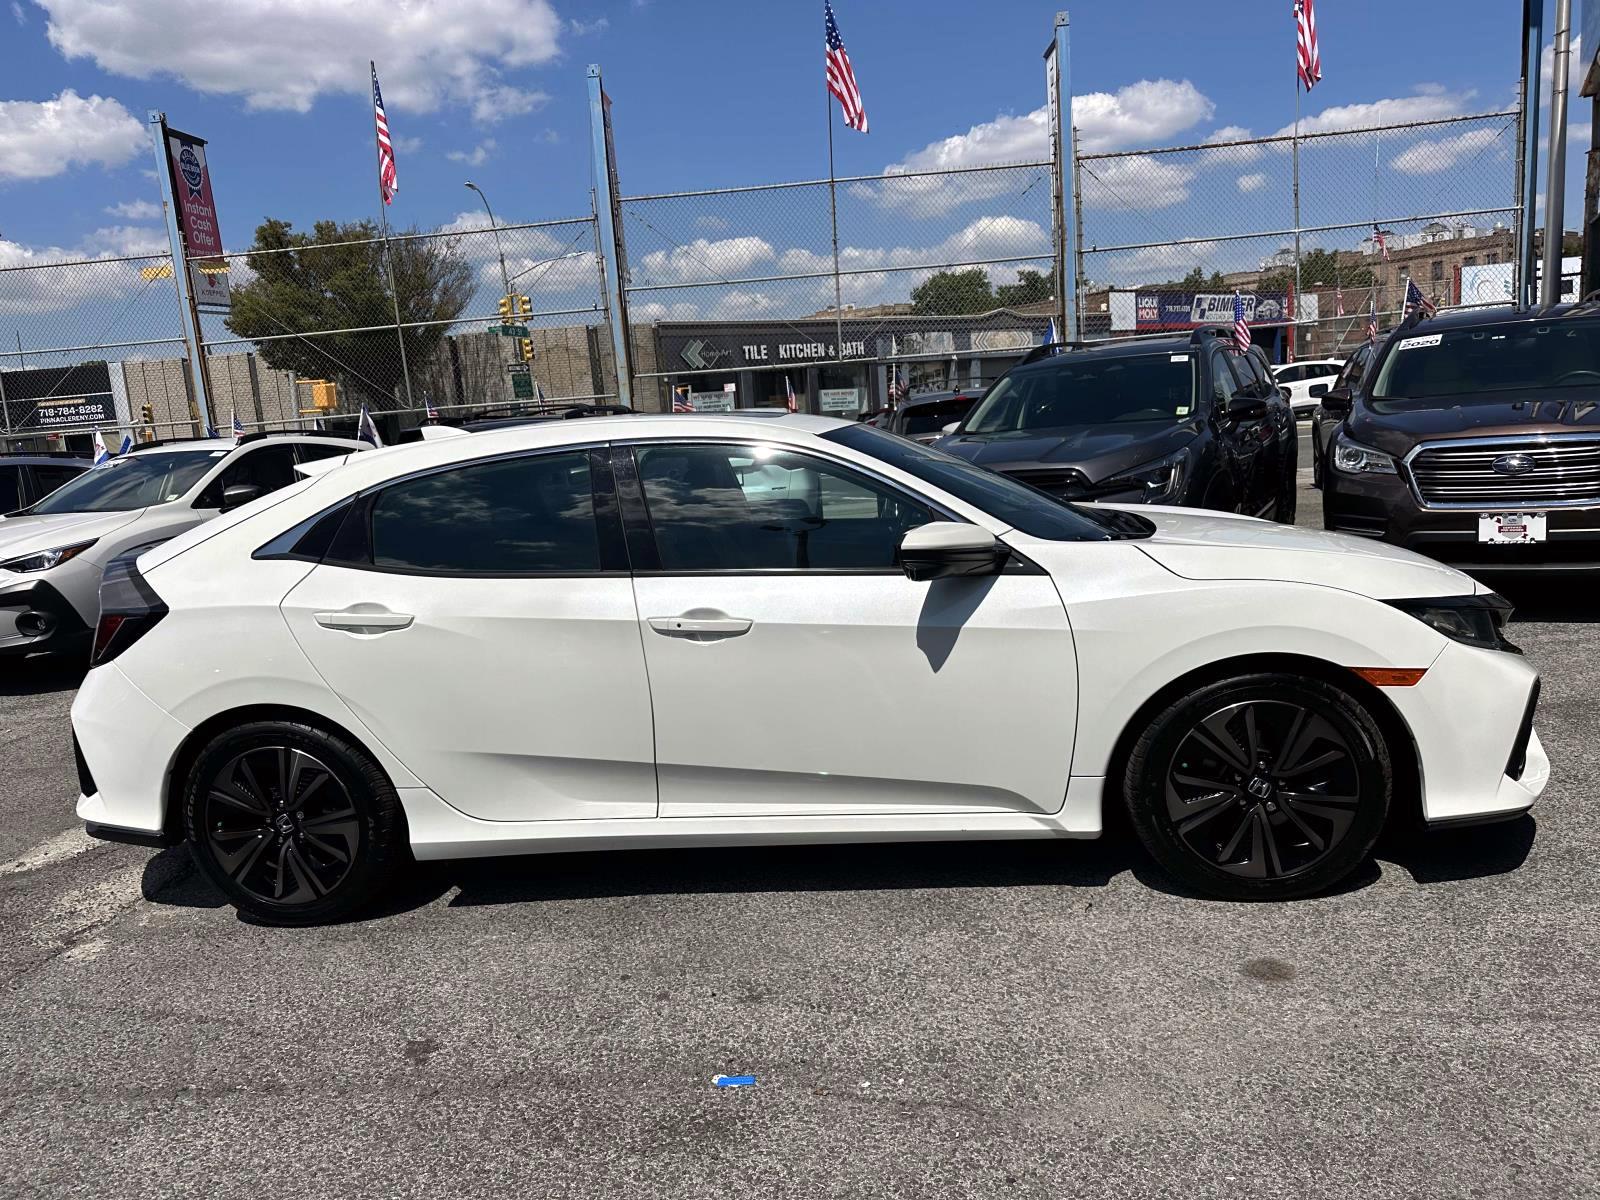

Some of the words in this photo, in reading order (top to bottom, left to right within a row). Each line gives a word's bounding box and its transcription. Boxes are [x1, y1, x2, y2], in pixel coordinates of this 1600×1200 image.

[184, 200, 212, 217] Instant
[190, 216, 212, 232] Cash
[193, 231, 214, 246] Offer
[1138, 297, 1158, 308] LIQUI
[1138, 308, 1158, 319] MOLY
[1401, 339, 1440, 349] 2020
[742, 344, 768, 360] TILE
[779, 342, 825, 359] KITCHEN
[828, 345, 835, 357] &
[38, 404, 104, 417] 718-784-8282
[40, 413, 105, 424] PINNACLERENY.COM
